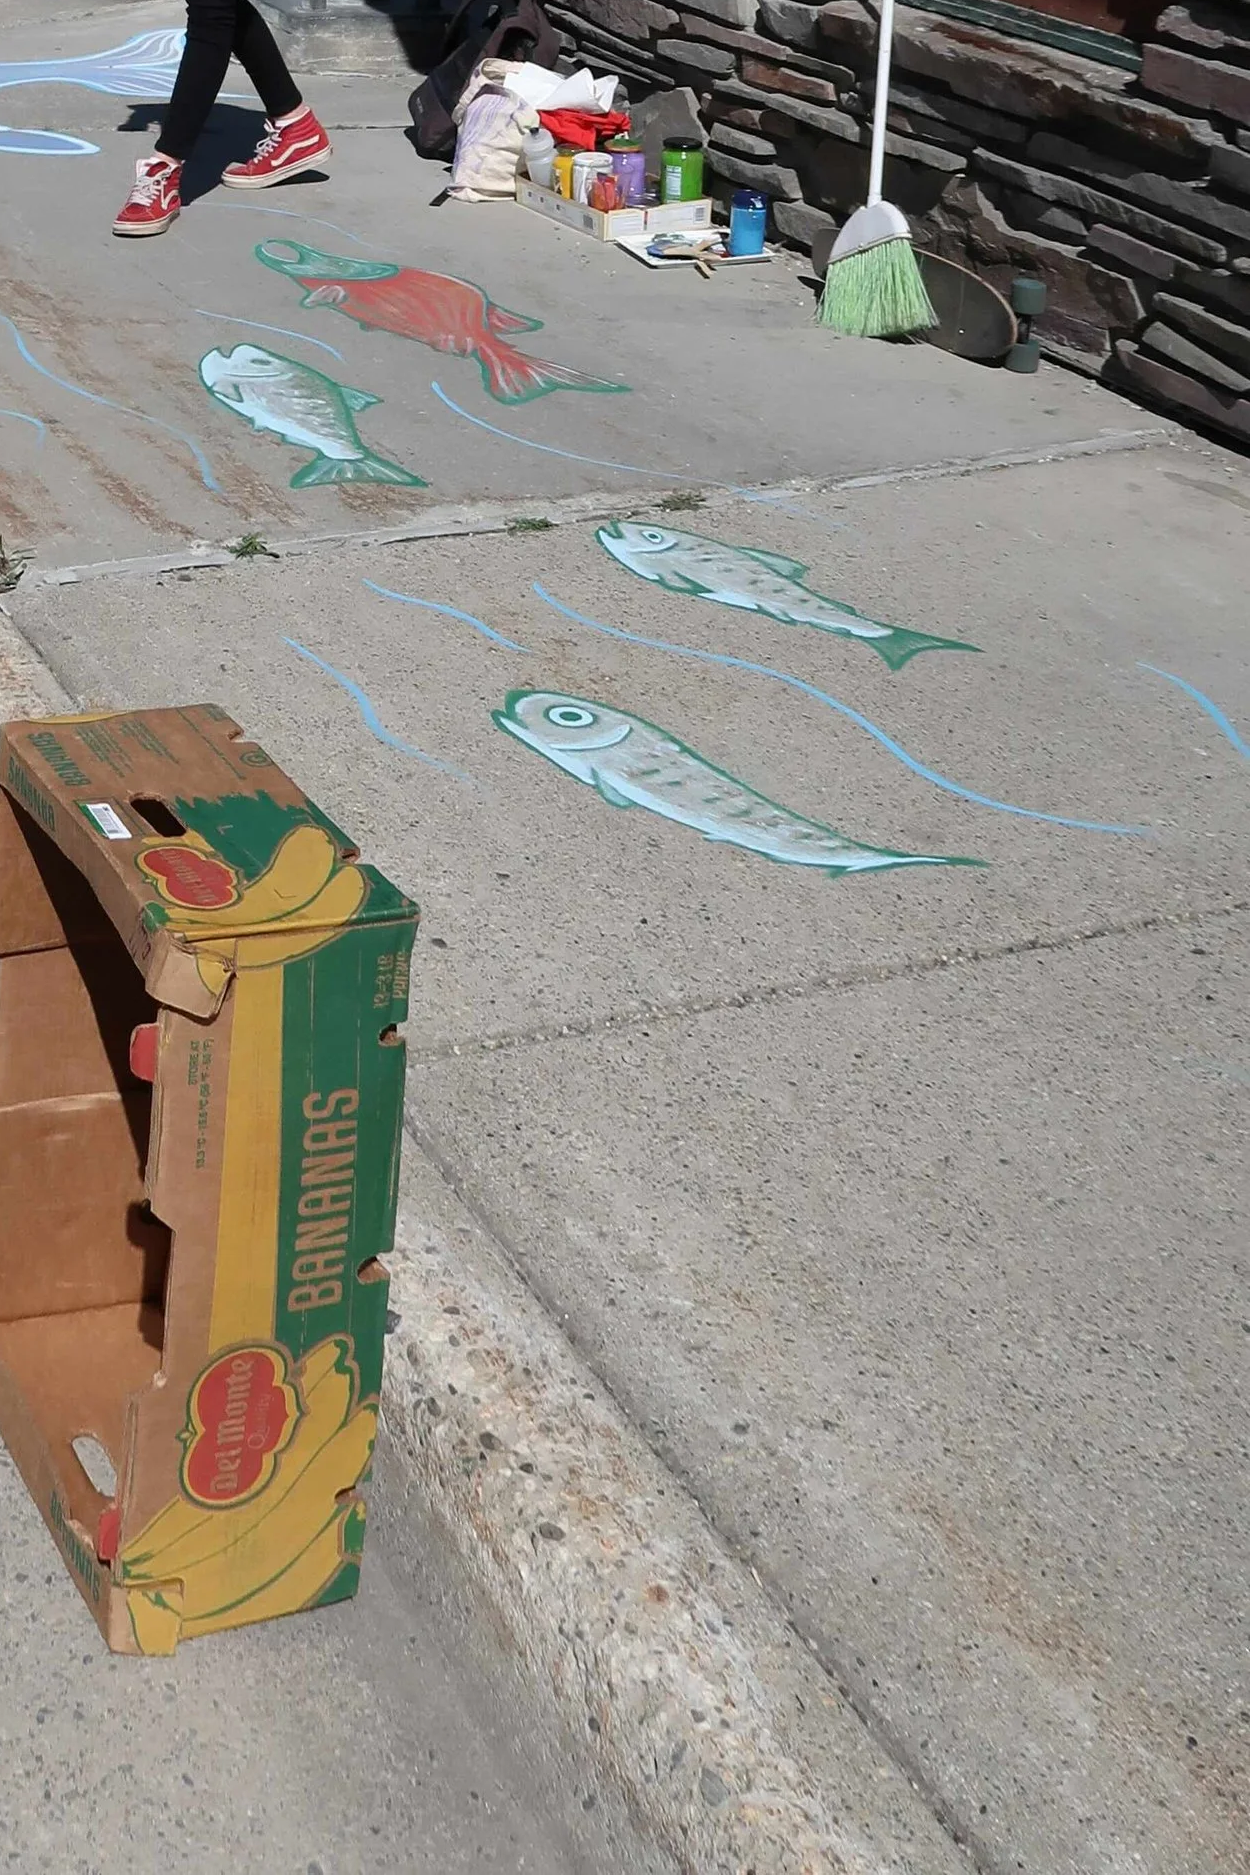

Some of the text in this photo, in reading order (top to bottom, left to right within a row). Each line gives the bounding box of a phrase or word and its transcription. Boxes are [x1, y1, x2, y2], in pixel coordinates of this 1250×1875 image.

[287, 1087, 360, 1313] BANANAS
[209, 1358, 254, 1494] Del Monte
[247, 1393, 275, 1450] Quality
